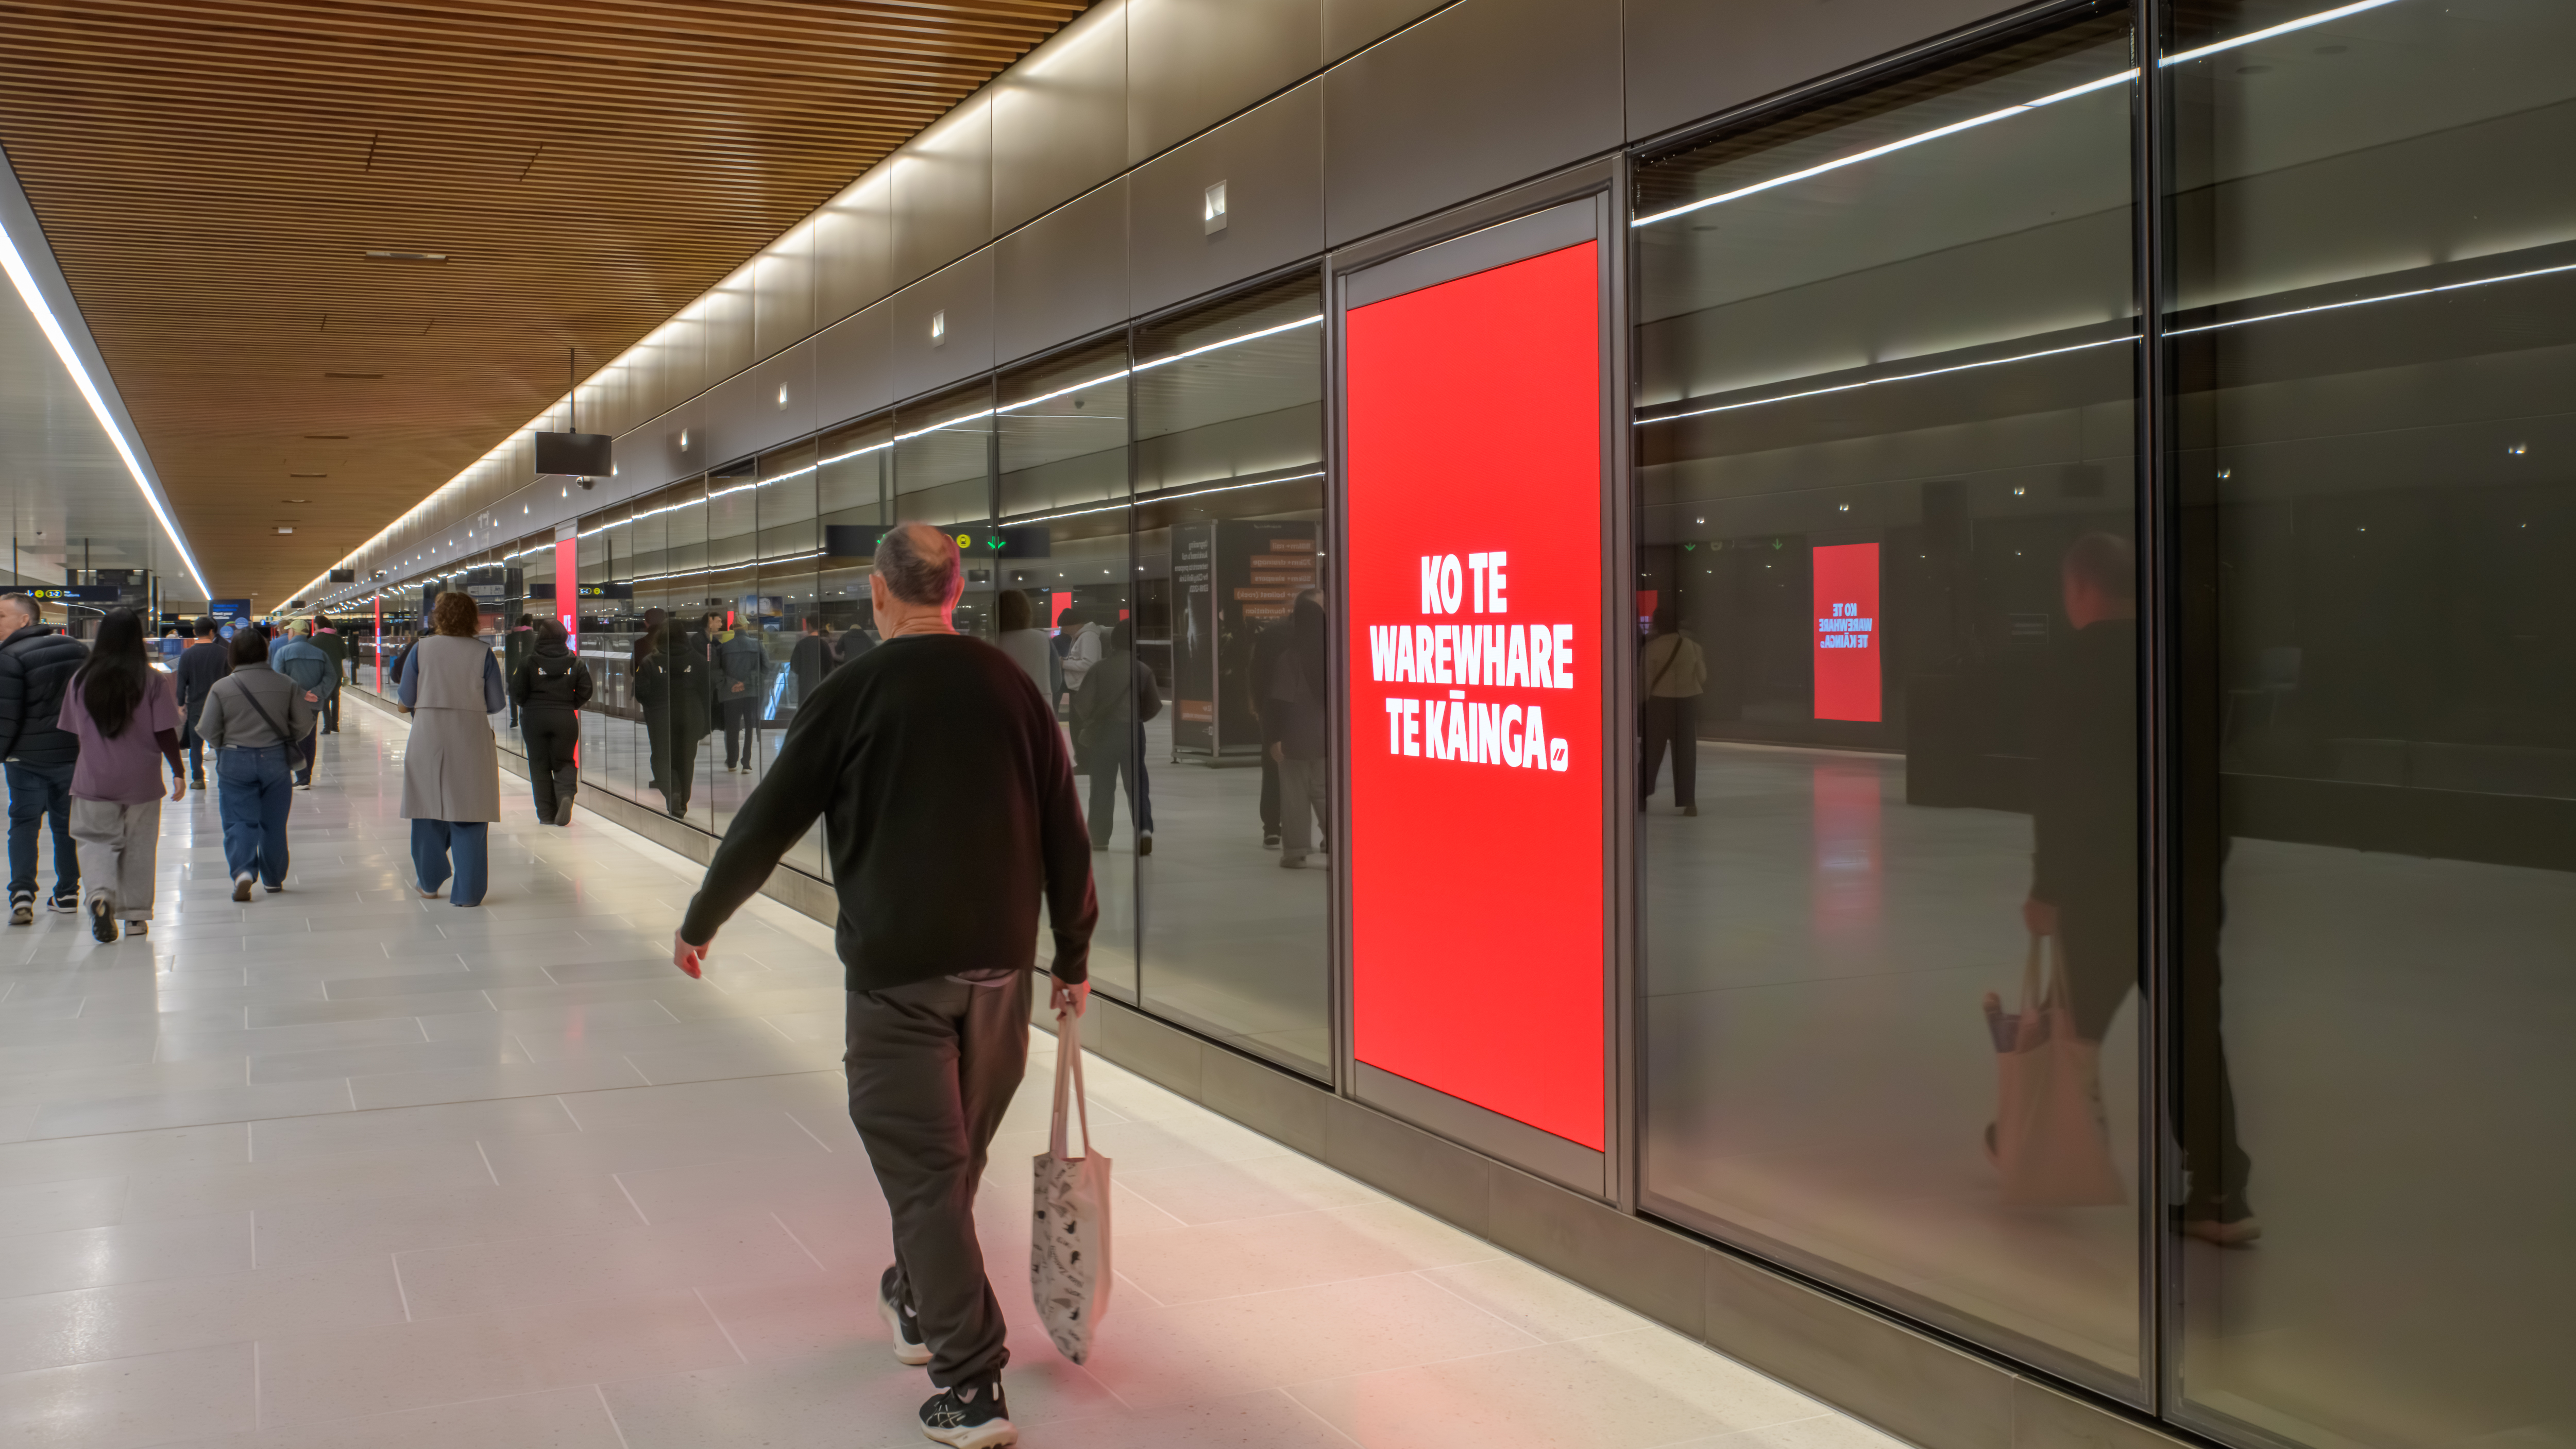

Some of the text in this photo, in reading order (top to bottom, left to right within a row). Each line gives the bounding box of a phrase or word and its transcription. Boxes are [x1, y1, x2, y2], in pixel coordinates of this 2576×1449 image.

[1421, 551, 1507, 615] KO TE
[1370, 624, 1573, 689] WAREWHARE
[1386, 690, 1548, 770] TE KĀINGA
